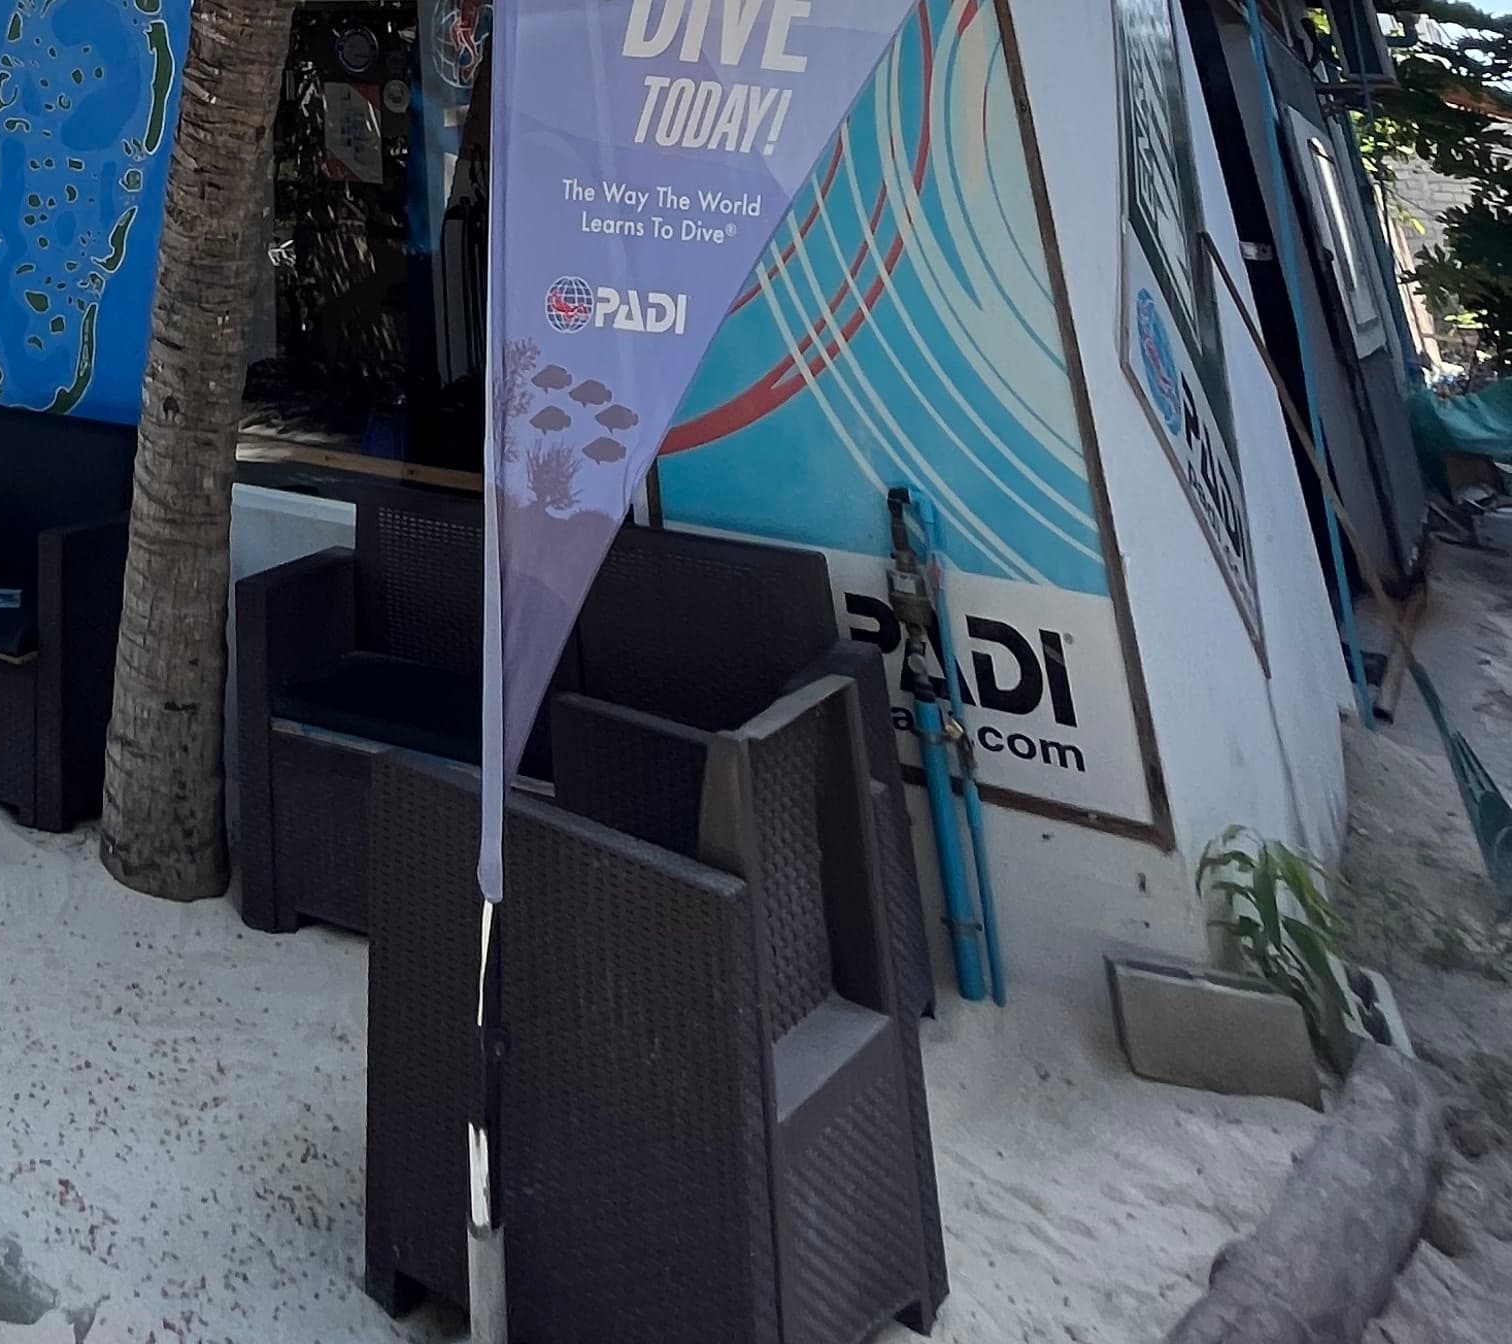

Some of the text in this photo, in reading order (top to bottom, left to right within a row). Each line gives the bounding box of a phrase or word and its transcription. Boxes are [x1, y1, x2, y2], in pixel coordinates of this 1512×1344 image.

[634, 74, 793, 157] TODAY!
[562, 178, 763, 217] The Way The World
[581, 211, 645, 238] Learns
[650, 216, 674, 240] To
[593, 285, 689, 336] PADI
